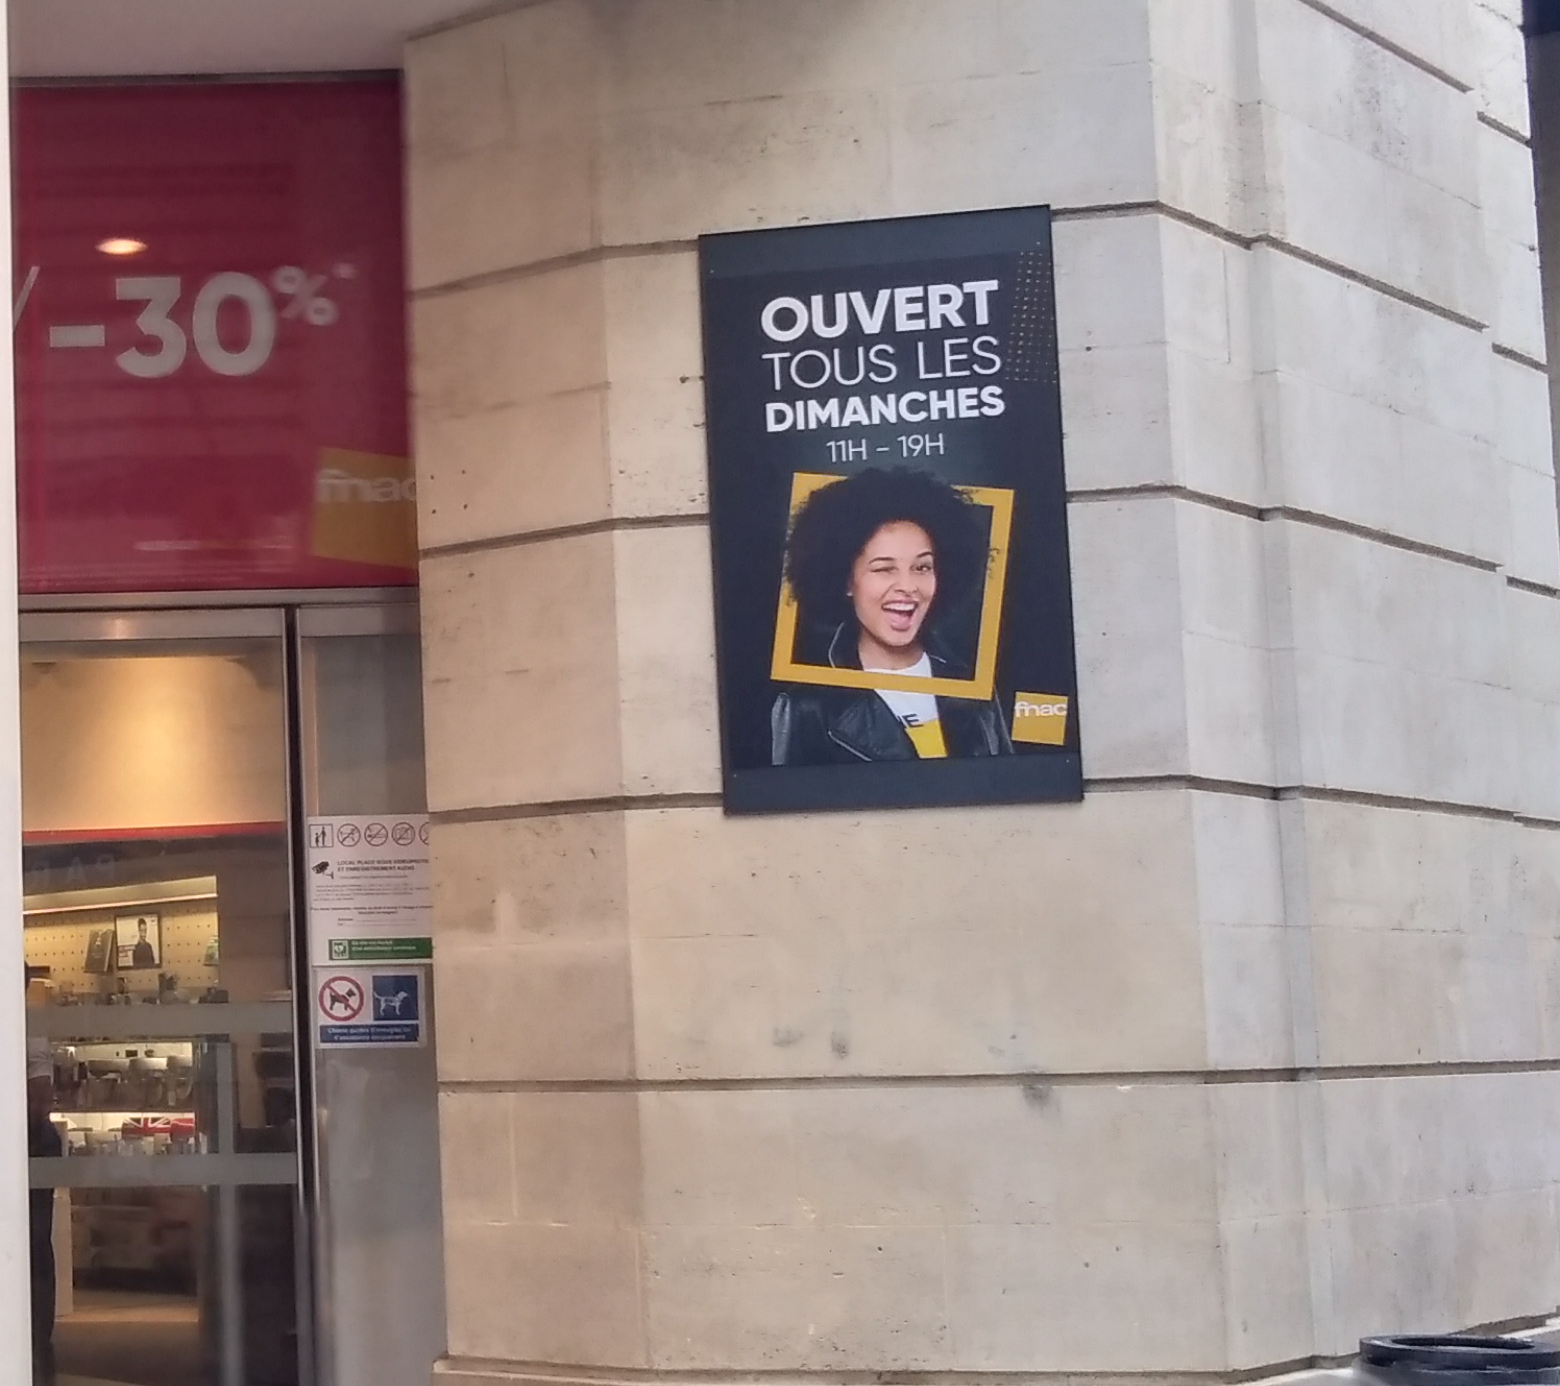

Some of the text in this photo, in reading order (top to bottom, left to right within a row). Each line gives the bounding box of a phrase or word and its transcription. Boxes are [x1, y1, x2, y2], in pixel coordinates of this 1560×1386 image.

[760, 279, 999, 342] OUVERT
[761, 335, 1002, 391] TOUS LES
[765, 384, 1006, 433] DIMANCHES
[827, 438, 868, 463] 11H
[897, 433, 946, 459] 19H
[1014, 700, 1068, 718] fnac
